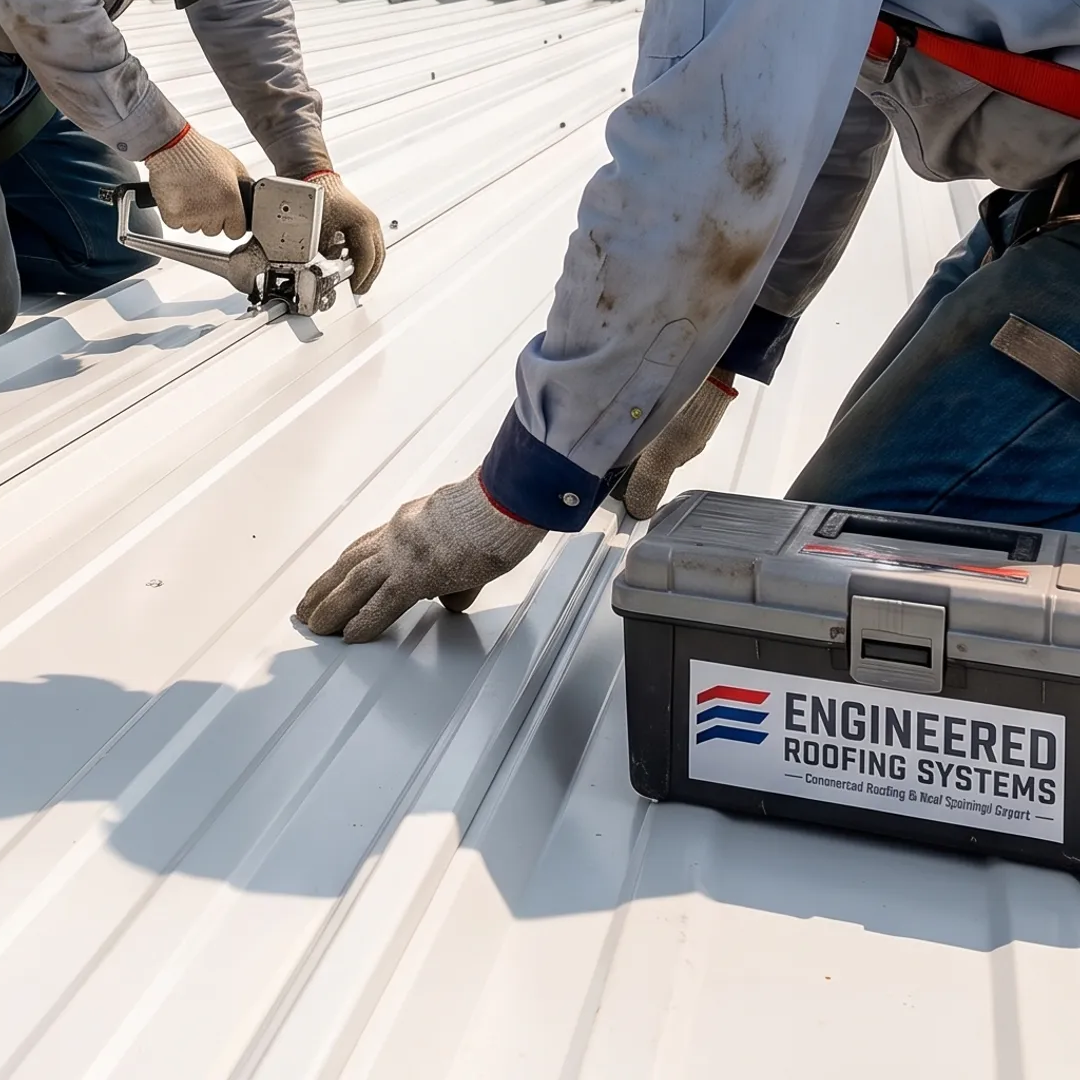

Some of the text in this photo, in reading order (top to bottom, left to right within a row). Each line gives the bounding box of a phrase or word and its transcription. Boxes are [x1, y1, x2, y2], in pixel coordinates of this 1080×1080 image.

[785, 691, 1057, 771] ENGINEERED
[784, 738, 1056, 805] ROOFING SYSTEMS
